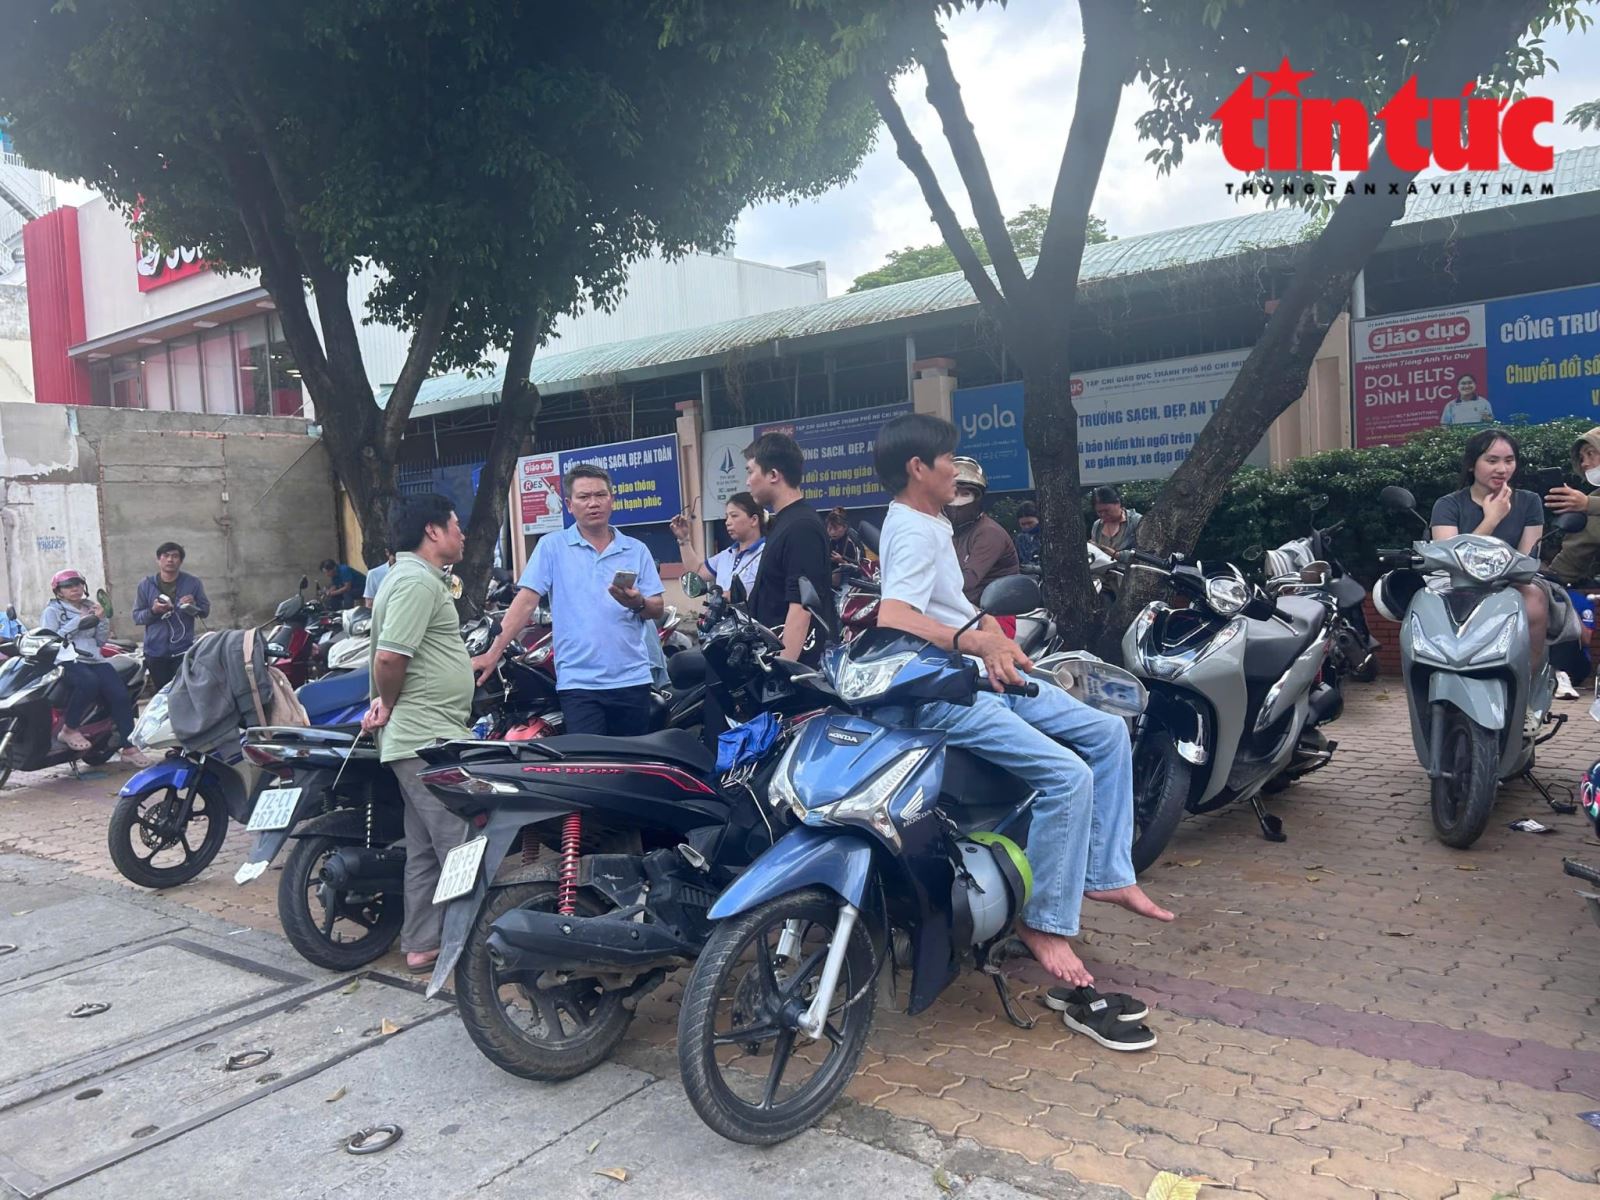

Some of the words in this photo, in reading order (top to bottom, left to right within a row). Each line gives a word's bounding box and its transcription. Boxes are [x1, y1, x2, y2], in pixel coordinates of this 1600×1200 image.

[1372, 327, 1420, 350] giáo
[1425, 322, 1466, 341] dục
[1500, 314, 1554, 344] CỔNG
[1557, 309, 1600, 336] TRƯ
[1365, 373, 1403, 389] DOL
[1408, 367, 1455, 384] IELTS
[1506, 357, 1557, 385] Chuyển
[1559, 354, 1582, 379] đổi
[1364, 389, 1410, 407] ĐÌNH
[1415, 385, 1452, 403] LỰC
[1190, 400, 1206, 415] AN
[962, 404, 1016, 439] yola
[1130, 436, 1145, 449] khi
[1171, 432, 1191, 445] trên
[643, 449, 652, 464] AN
[653, 445, 672, 463] TOÀN
[1085, 458, 1096, 469] xe
[1141, 453, 1152, 464] xe
[1174, 447, 1191, 461] điệ
[830, 468, 853, 480] trong
[634, 479, 656, 492] thông
[902, 809, 933, 828] HONDA
